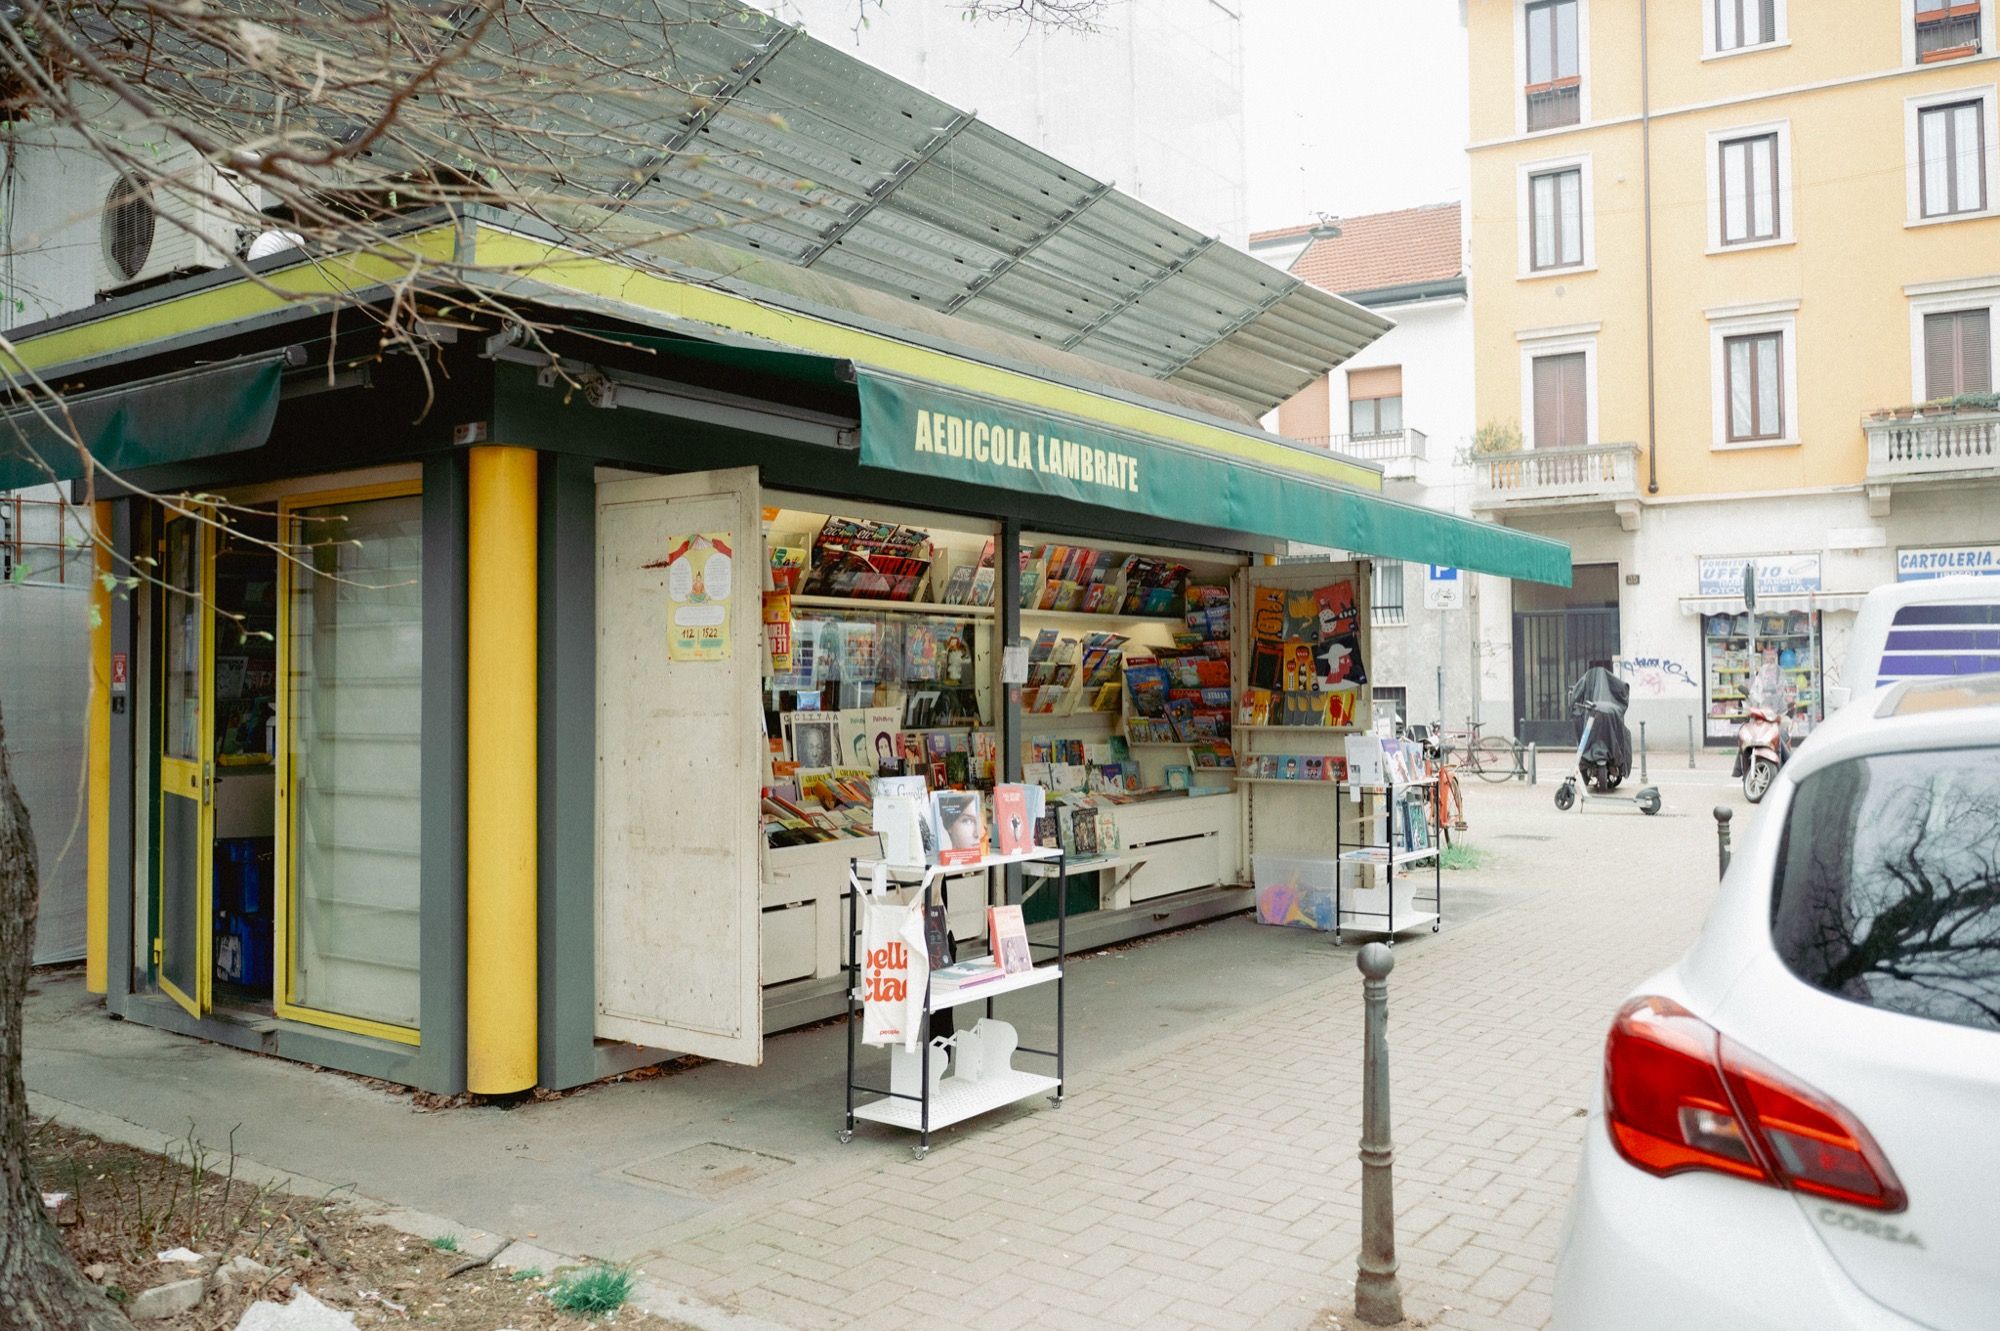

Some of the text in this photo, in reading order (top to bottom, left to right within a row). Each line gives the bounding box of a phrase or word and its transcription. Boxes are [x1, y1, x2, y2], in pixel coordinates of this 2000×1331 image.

[914, 408, 1139, 493] AEDICOLA LAMBRATE
[1900, 550, 1991, 569] CARTOLERIA
[682, 628, 695, 638] 112
[703, 627, 718, 638] 1522
[1818, 1207, 1927, 1250] CORSA
